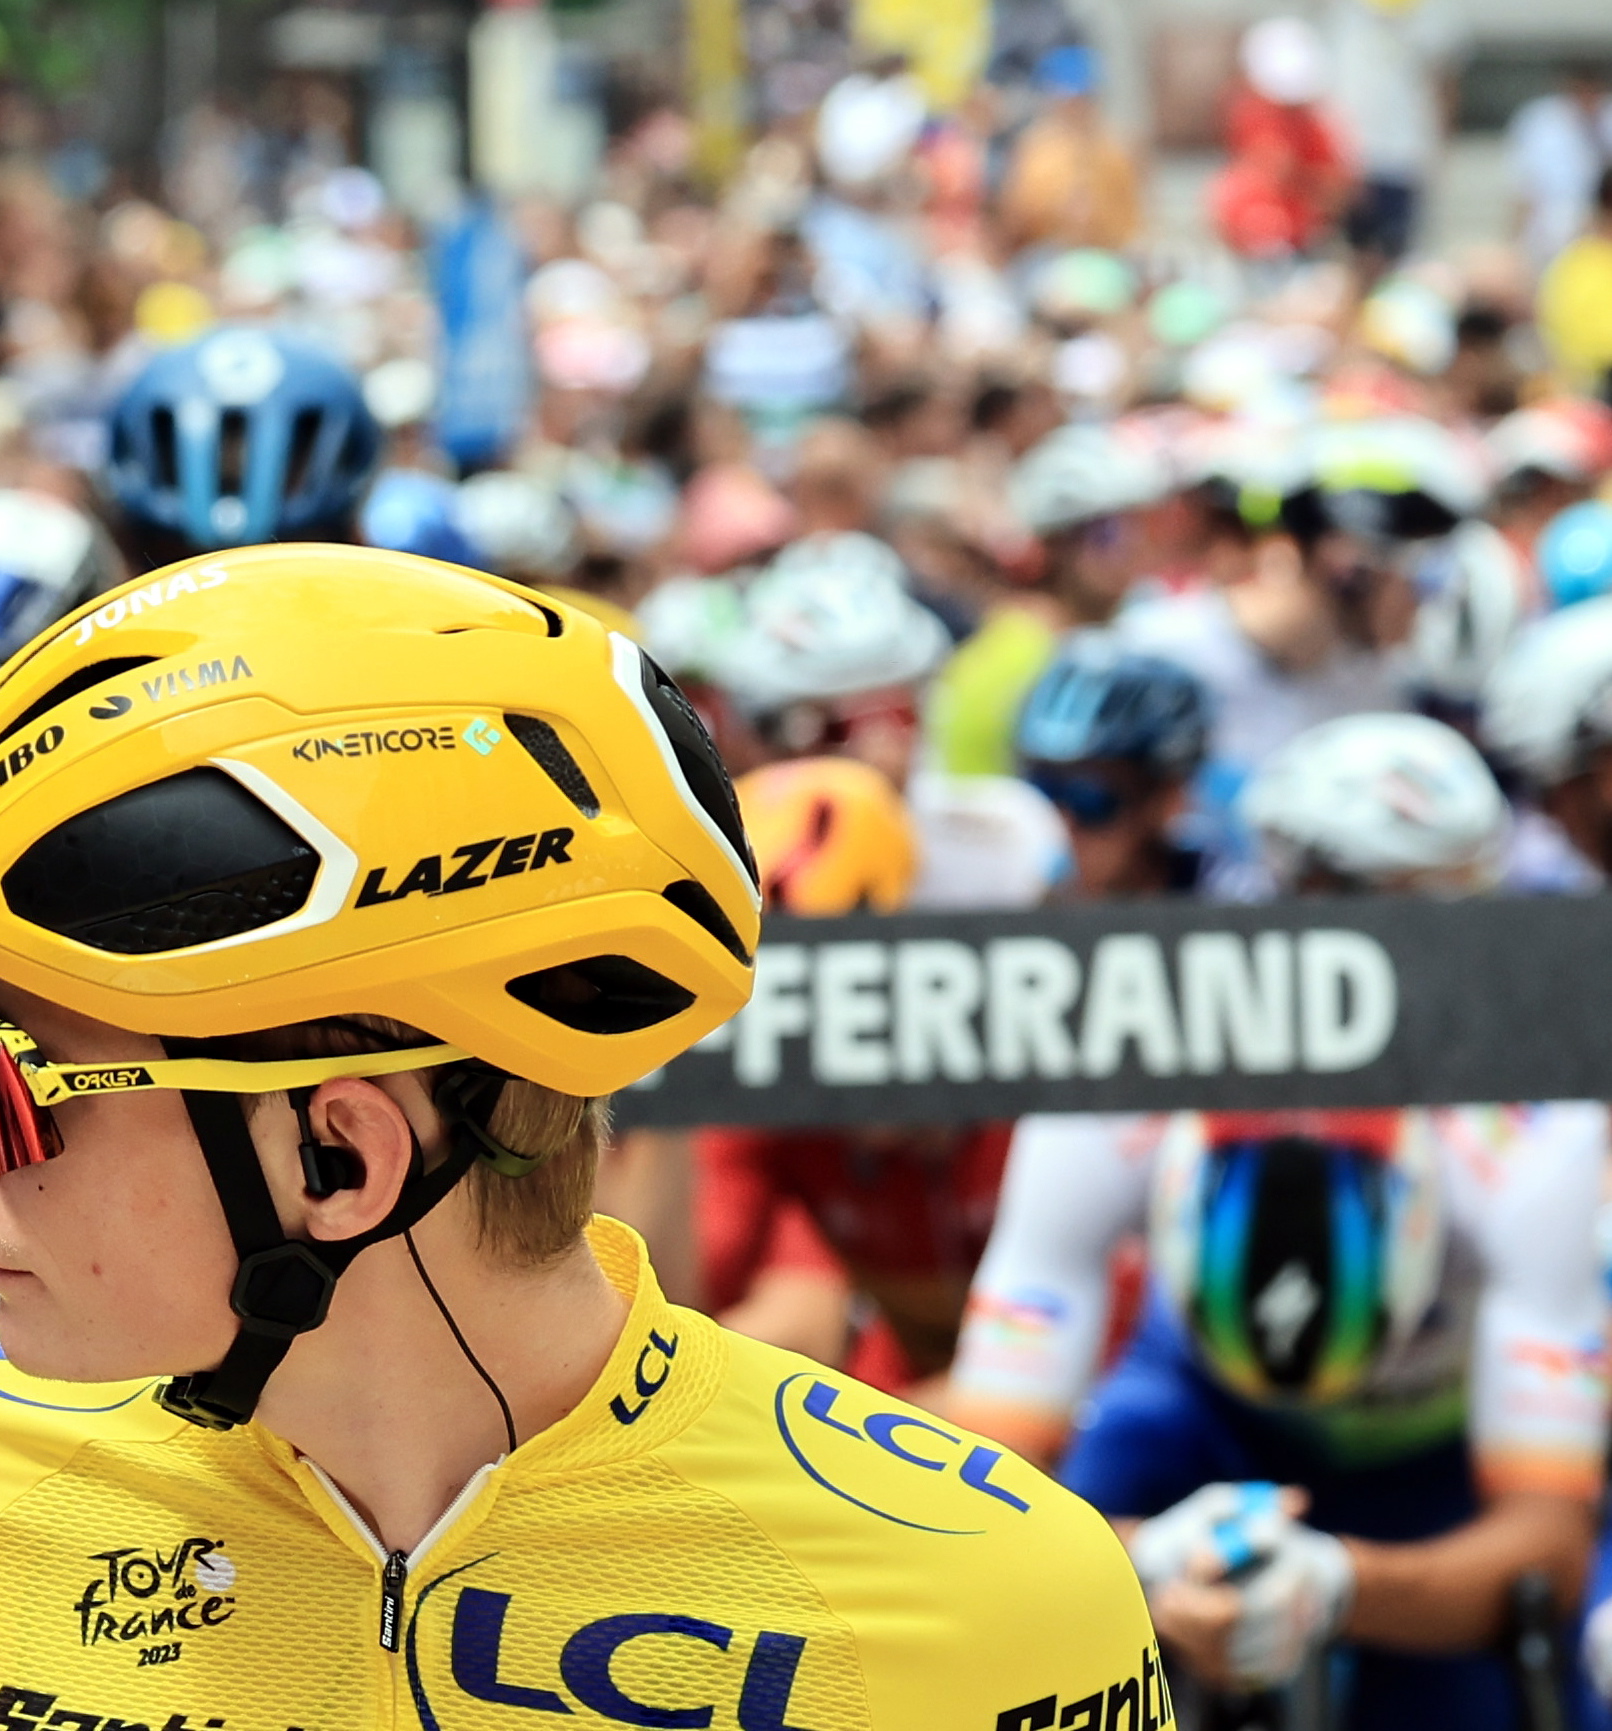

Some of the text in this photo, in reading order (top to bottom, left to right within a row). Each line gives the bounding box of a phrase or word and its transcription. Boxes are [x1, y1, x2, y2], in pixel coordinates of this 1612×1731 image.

[72, 562, 228, 647] JONAS
[140, 654, 254, 703] VISMA
[292, 724, 456, 764] KINETICORE
[354, 826, 575, 911] LAZER
[71, 1070, 145, 1092] OAKLEY
[610, 1329, 679, 1425] LCL
[803, 1379, 1032, 1514] LCL
[87, 1537, 224, 1602] TOUR
[174, 1578, 197, 1600] de
[380, 1596, 397, 1650] Santini
[137, 1641, 182, 1667] 2023
